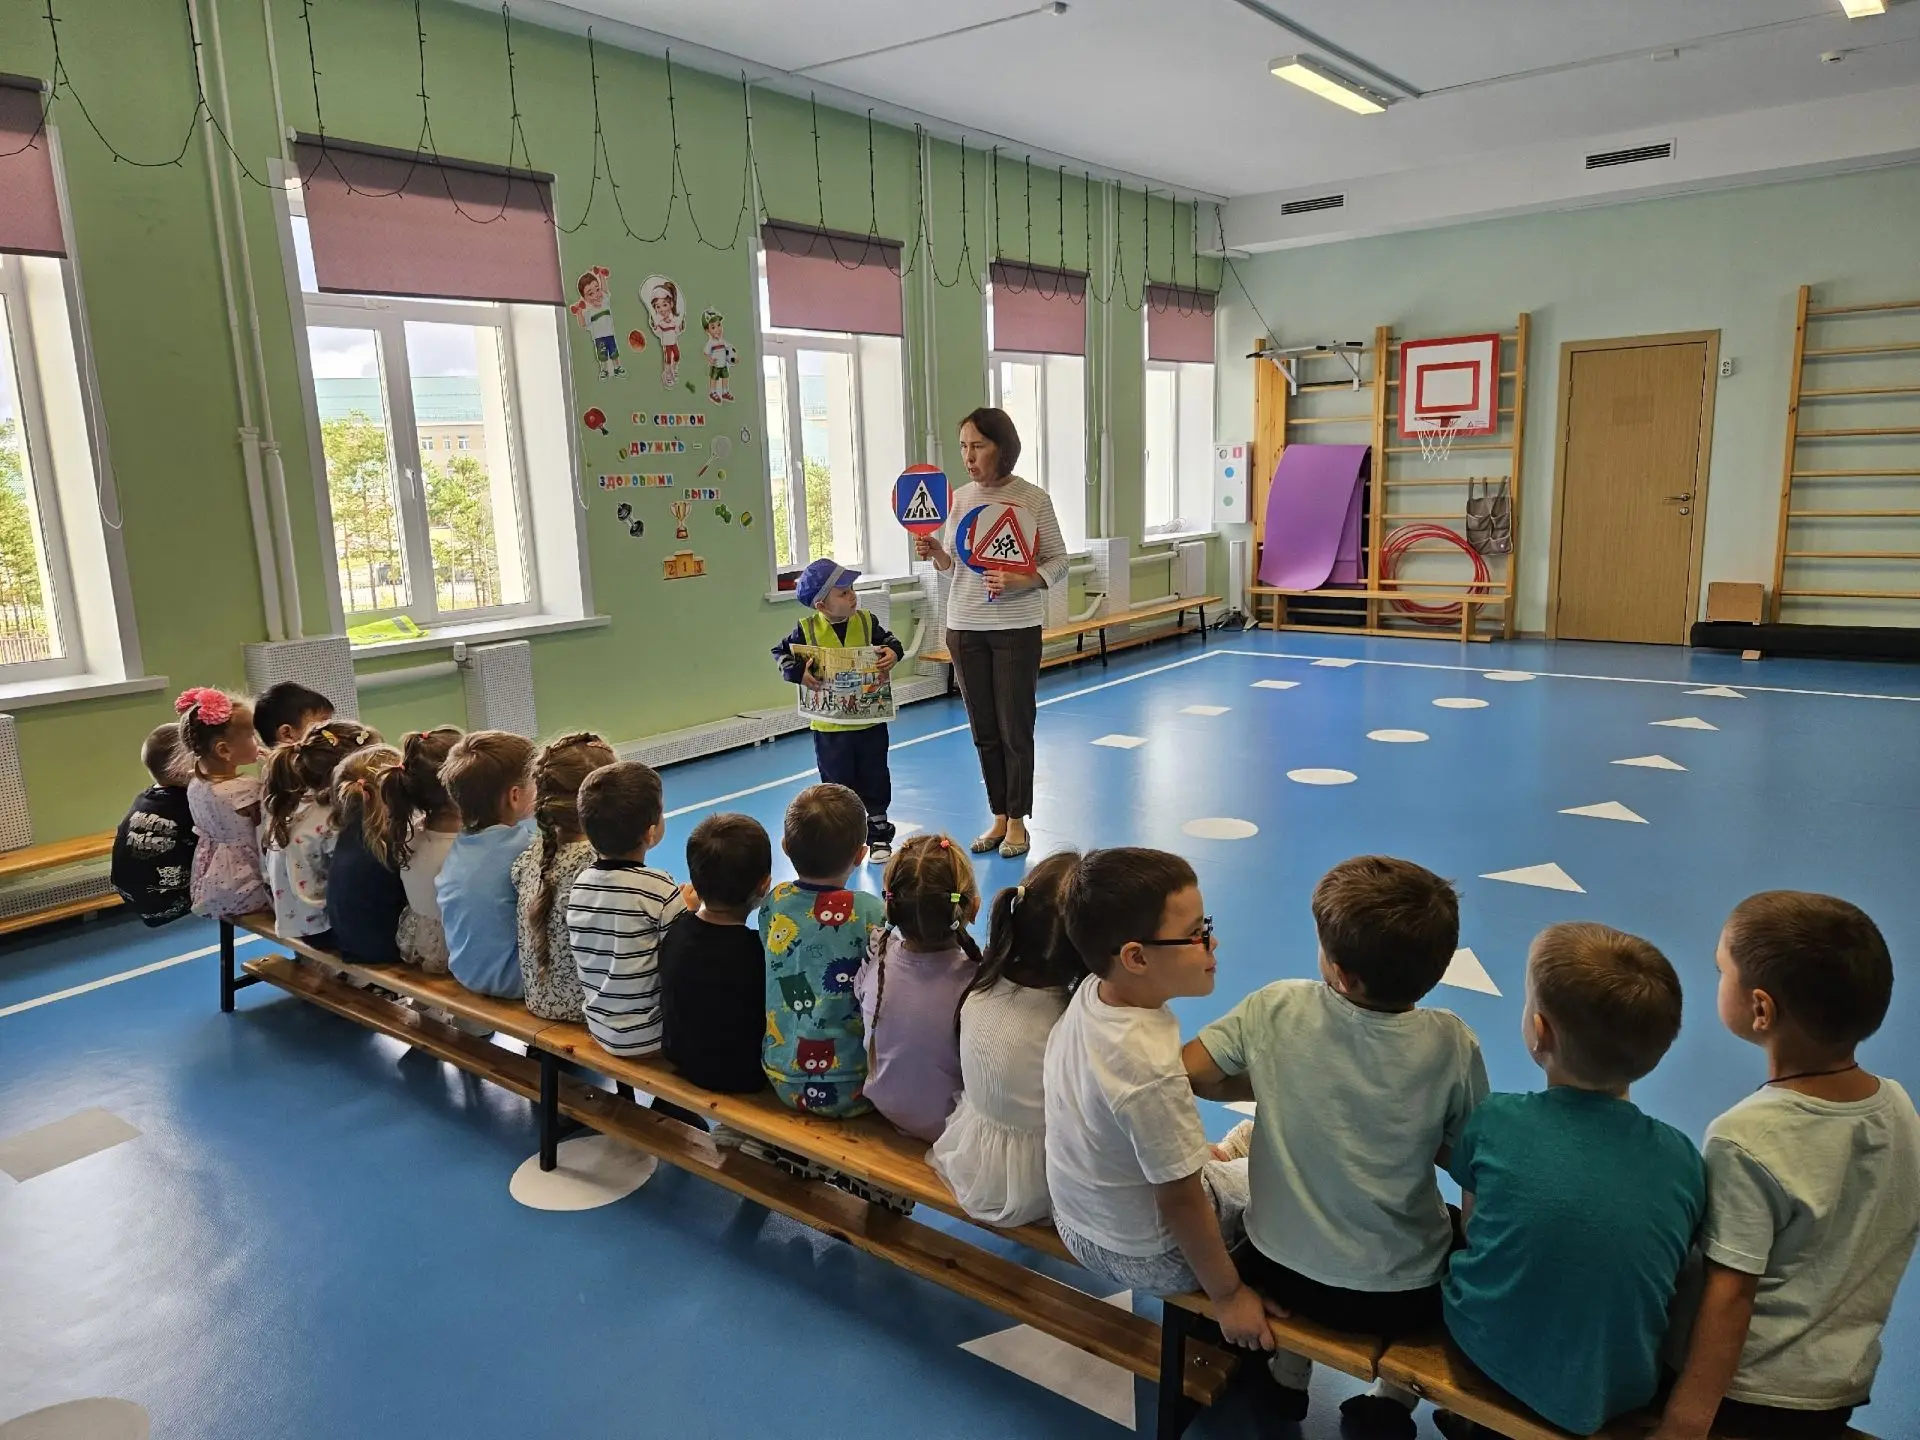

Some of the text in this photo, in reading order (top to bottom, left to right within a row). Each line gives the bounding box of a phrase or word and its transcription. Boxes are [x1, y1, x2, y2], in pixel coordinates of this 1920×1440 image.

[632, 414, 704, 426] СО СПОРТОМ
[630, 442, 685, 455] ДРУЖИТЬ
[600, 475, 673, 489] ЗДОРОВЫМИ
[685, 489, 719, 500] БЫТЬ!
[668, 564, 675, 576] 2
